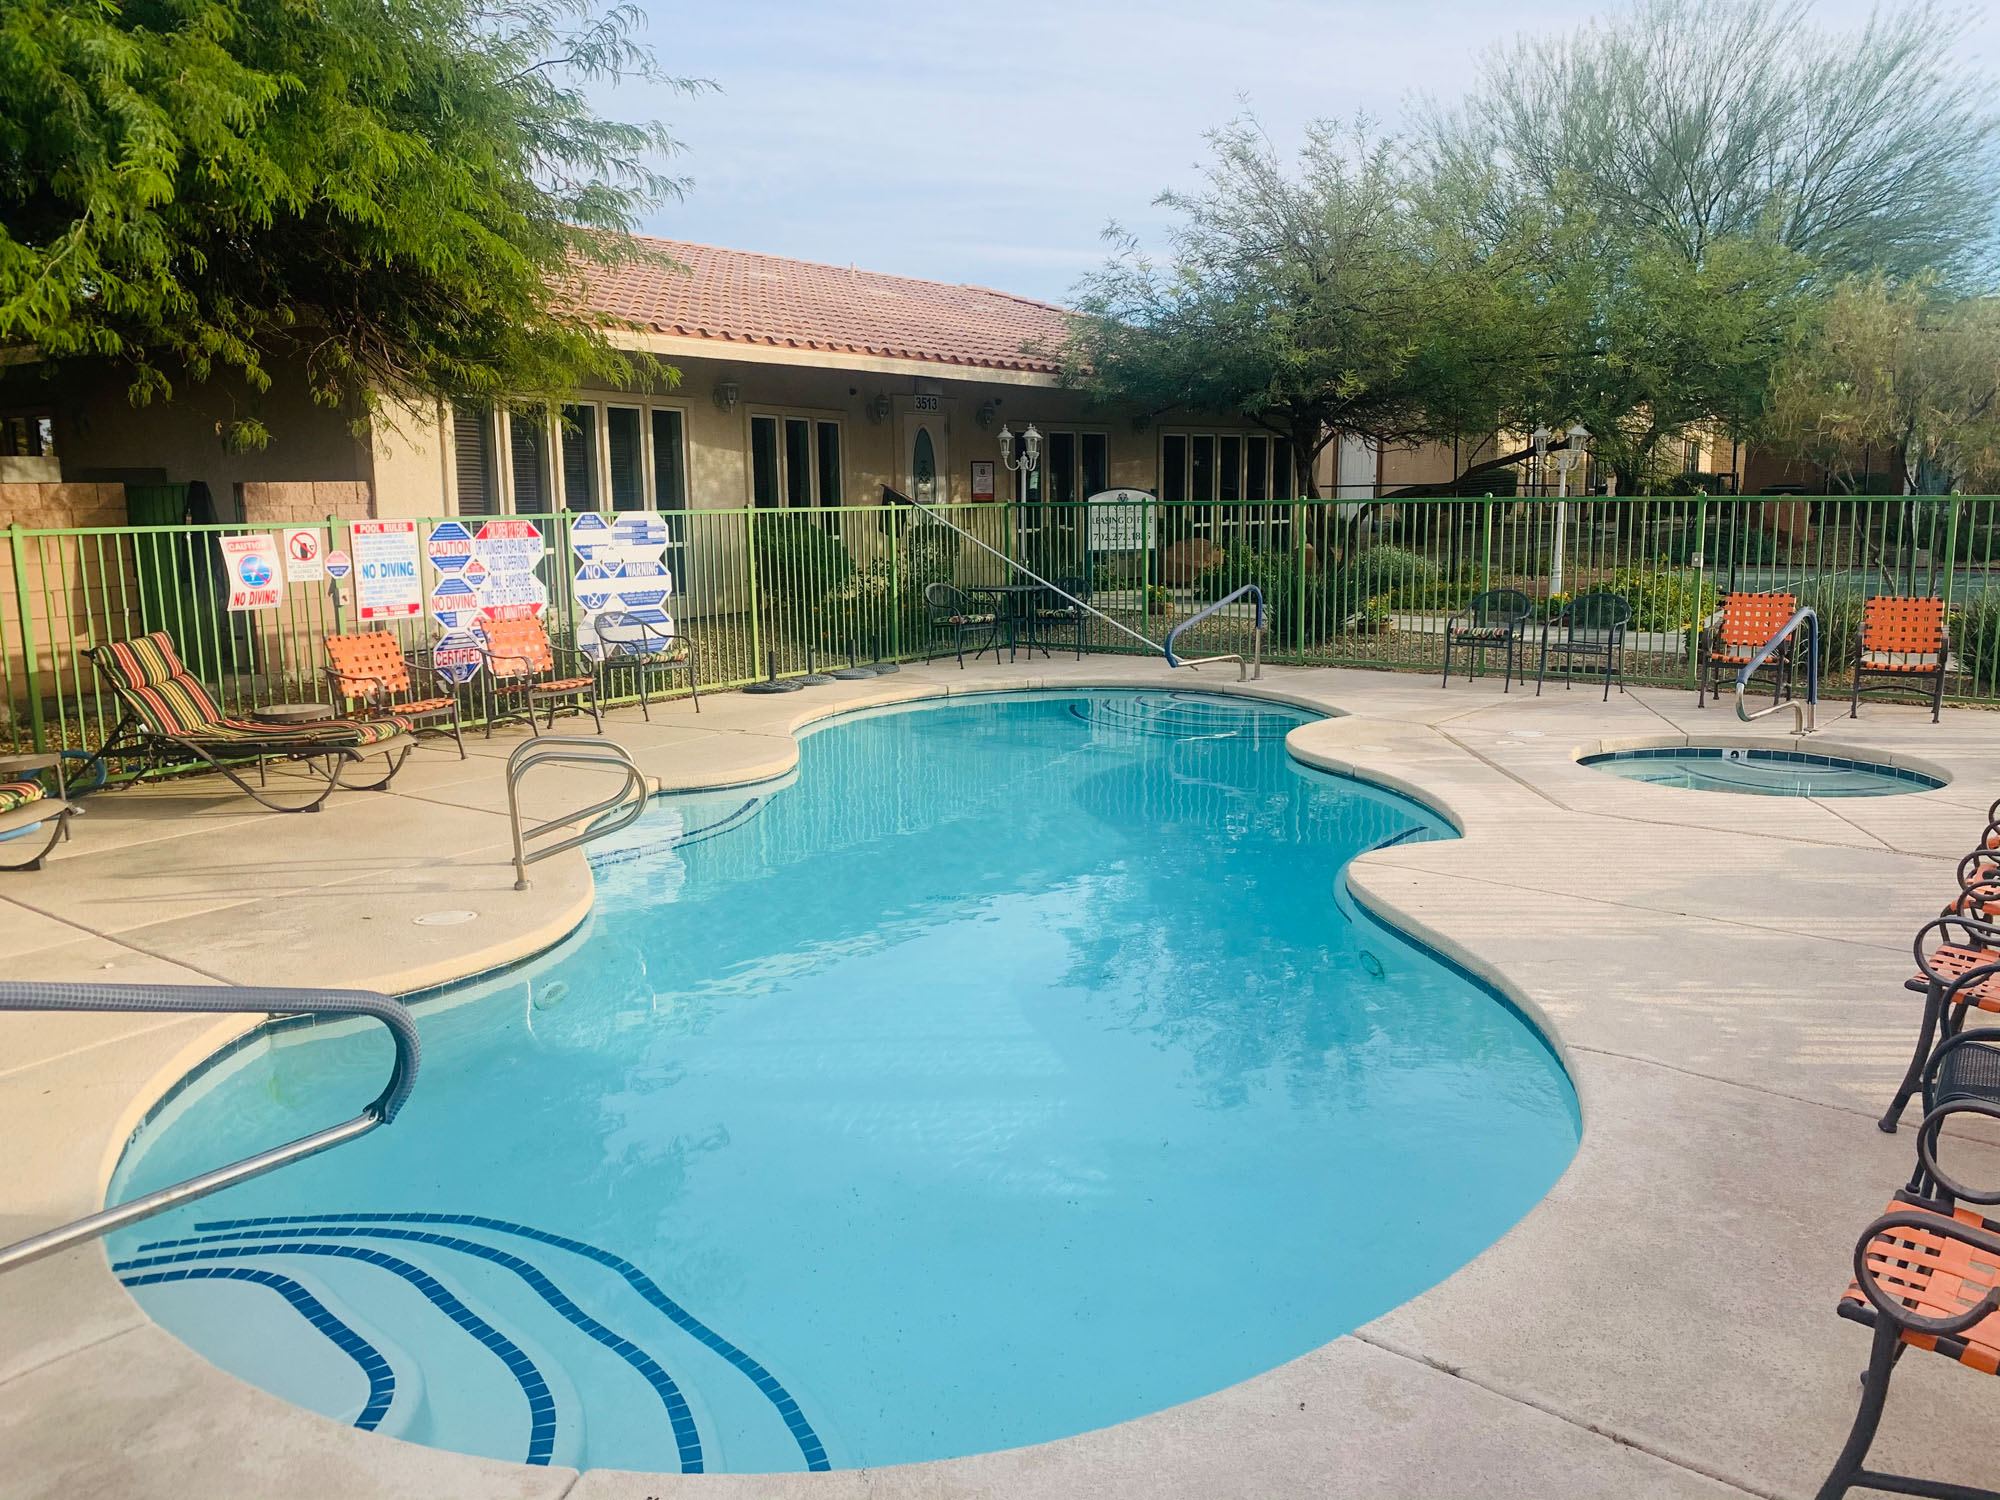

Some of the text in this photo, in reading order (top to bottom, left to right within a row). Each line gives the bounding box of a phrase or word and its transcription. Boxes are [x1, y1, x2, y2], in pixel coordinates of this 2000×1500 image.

[915, 397, 937, 410] 3513
[1092, 516, 1124, 524] LEASING
[360, 523, 408, 533] POOL RULES
[487, 522, 508, 539] CHILDREN
[514, 521, 528, 538] YEARS
[428, 541, 471, 556] CAUTION
[483, 540, 503, 555] YOUNGER
[529, 538, 541, 553] HAVE
[489, 556, 503, 571] ADULT
[625, 562, 659, 577] WARNING
[362, 564, 376, 579] NO
[585, 565, 601, 579] NO
[505, 572, 531, 587] EXPOSURE
[233, 589, 278, 606] NO DIVING!
[431, 594, 478, 612] NO DIVING
[481, 590, 495, 605] TIME
[496, 589, 507, 604] FOR
[509, 588, 536, 602] CHILDREN
[494, 605, 532, 620] 10 MINUTES
[435, 648, 482, 667] CERTIFIED
